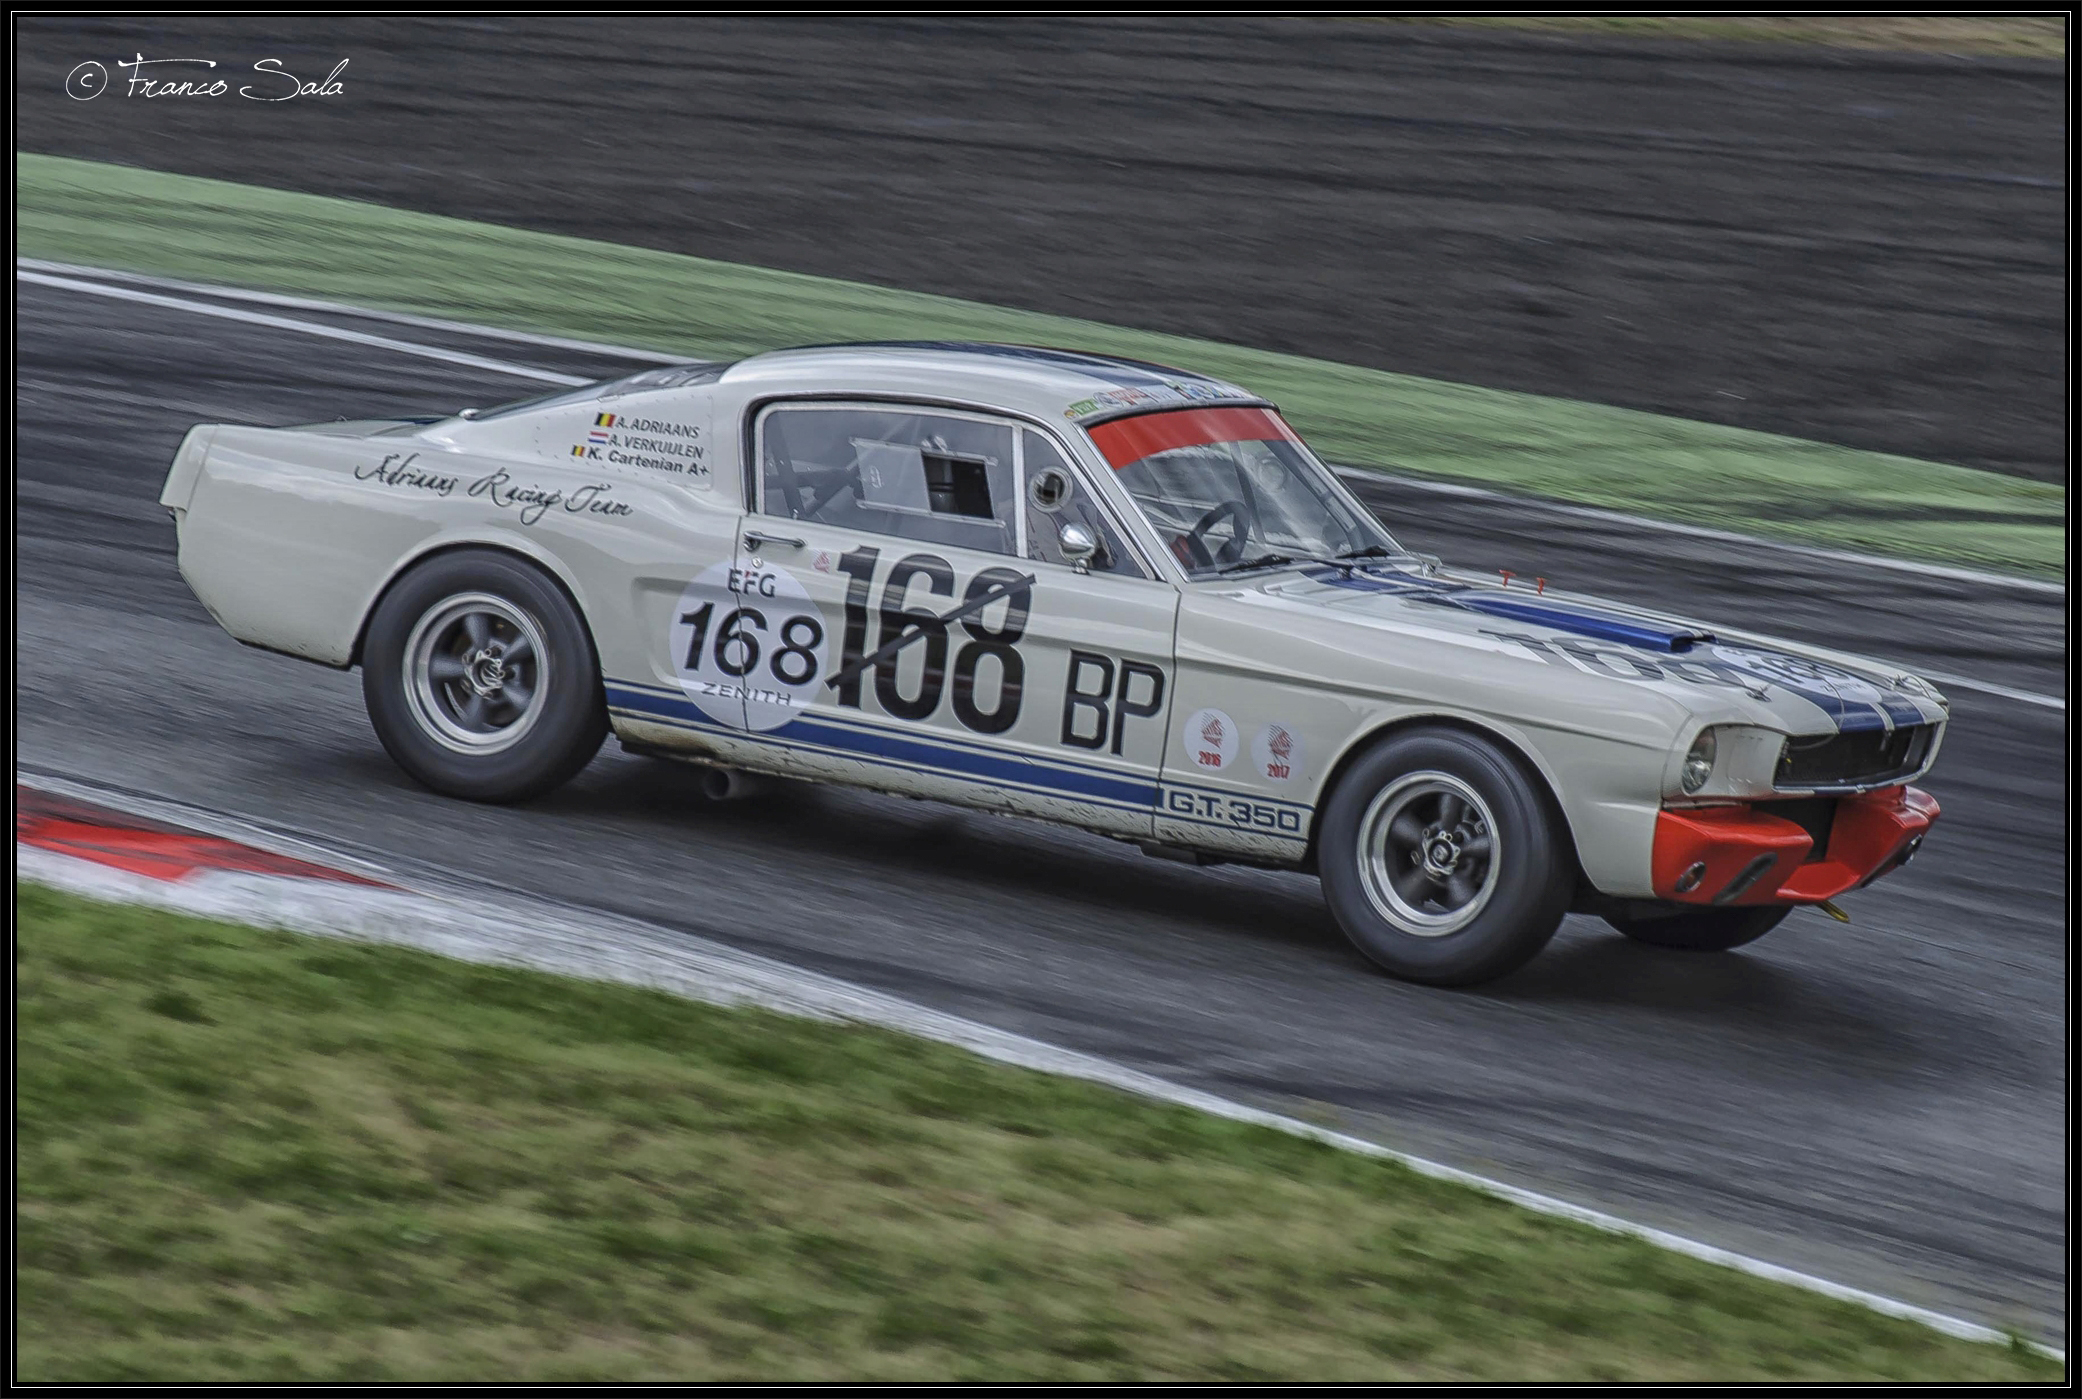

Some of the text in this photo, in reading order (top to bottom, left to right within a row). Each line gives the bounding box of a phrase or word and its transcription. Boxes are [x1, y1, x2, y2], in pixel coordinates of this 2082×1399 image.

[608, 433, 621, 447] A.
[631, 418, 700, 439] ADRIAANS
[587, 446, 603, 461] K.
[608, 449, 683, 473] Cartenian
[354, 453, 634, 526] Adriaans Racing Team
[728, 568, 777, 599] EFG
[679, 601, 824, 687] 168
[838, 545, 1032, 735] 168
[701, 682, 792, 707] ZENITH
[1060, 648, 1166, 757] BP
[1170, 790, 1300, 832] G.T. 350
